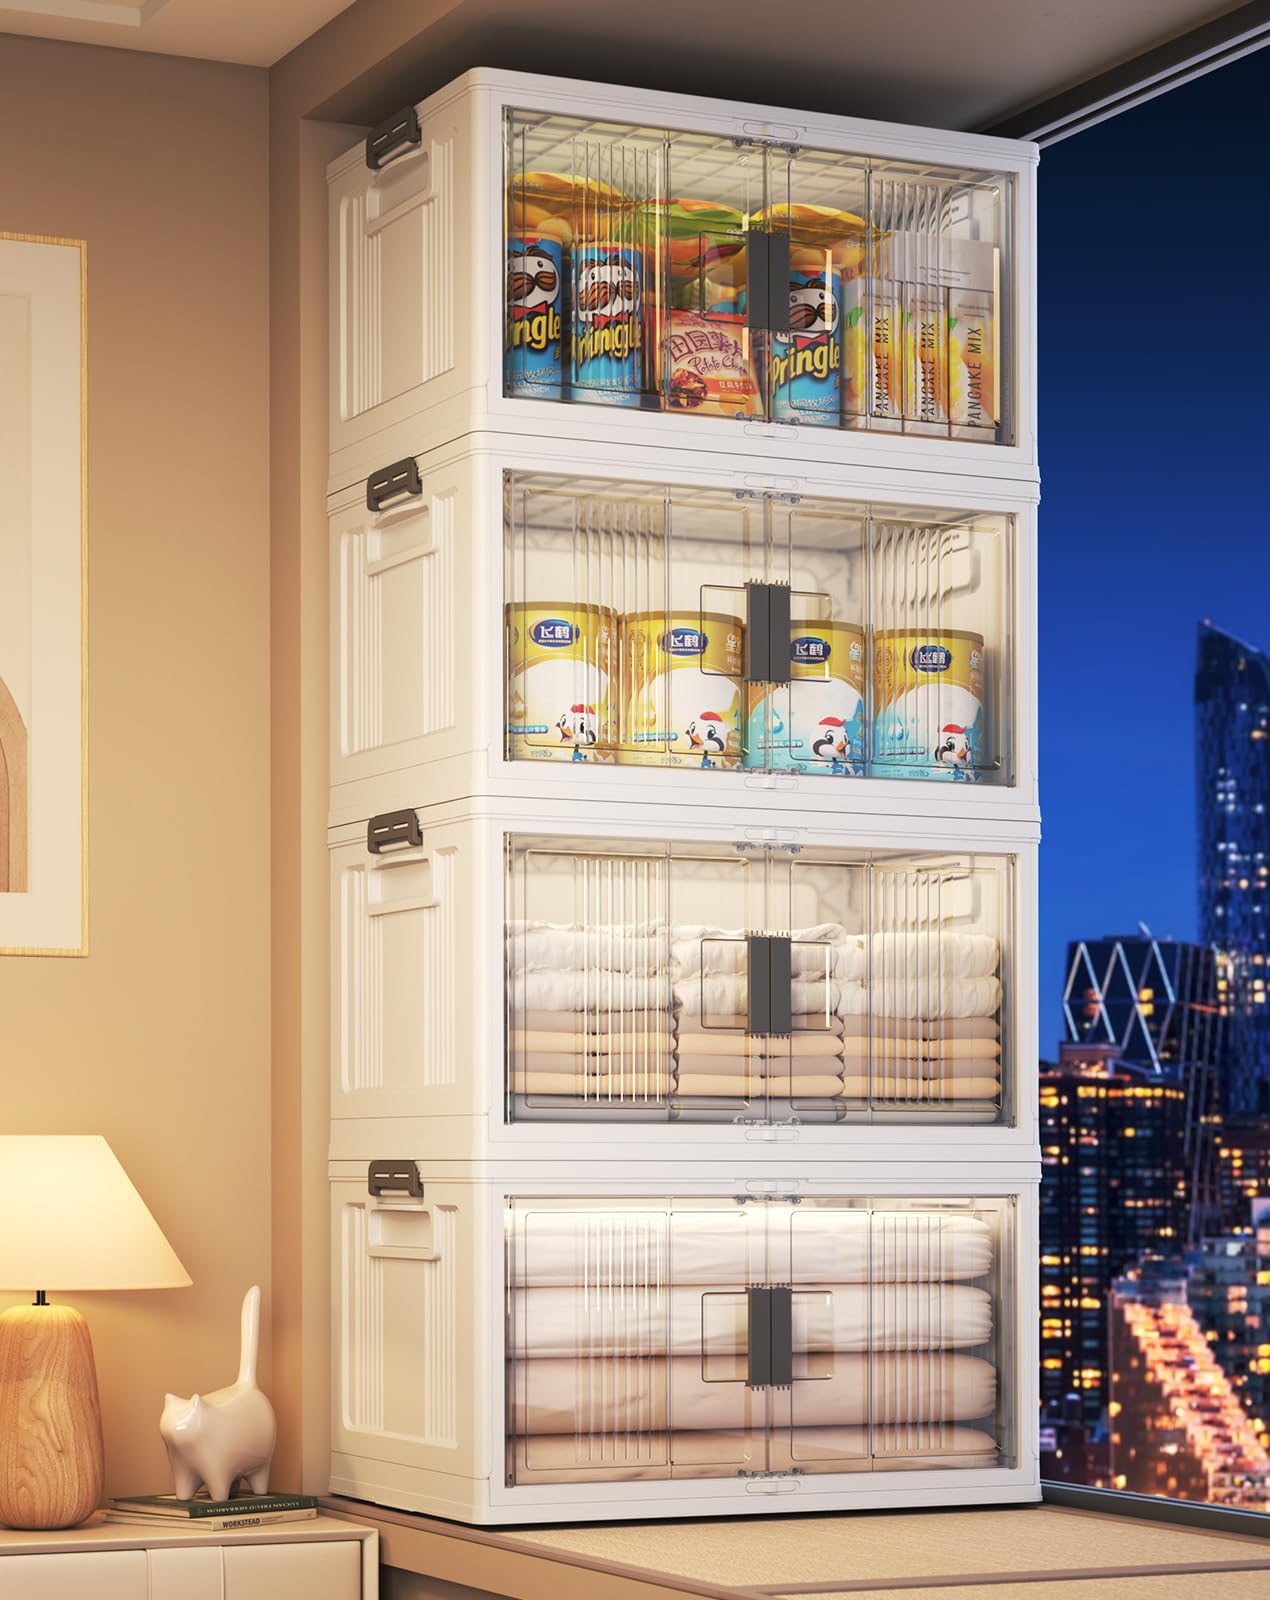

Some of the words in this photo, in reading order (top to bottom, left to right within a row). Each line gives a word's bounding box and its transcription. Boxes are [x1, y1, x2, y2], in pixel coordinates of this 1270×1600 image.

[967, 327, 982, 354] MIX
[967, 362, 982, 426] PANCAKE
[540, 625, 570, 639] 飞鹤
[670, 634, 699, 648] 飞鹤
[795, 642, 824, 656] 飞鹤
[222, 1517, 261, 1529] WORKSTEAD
